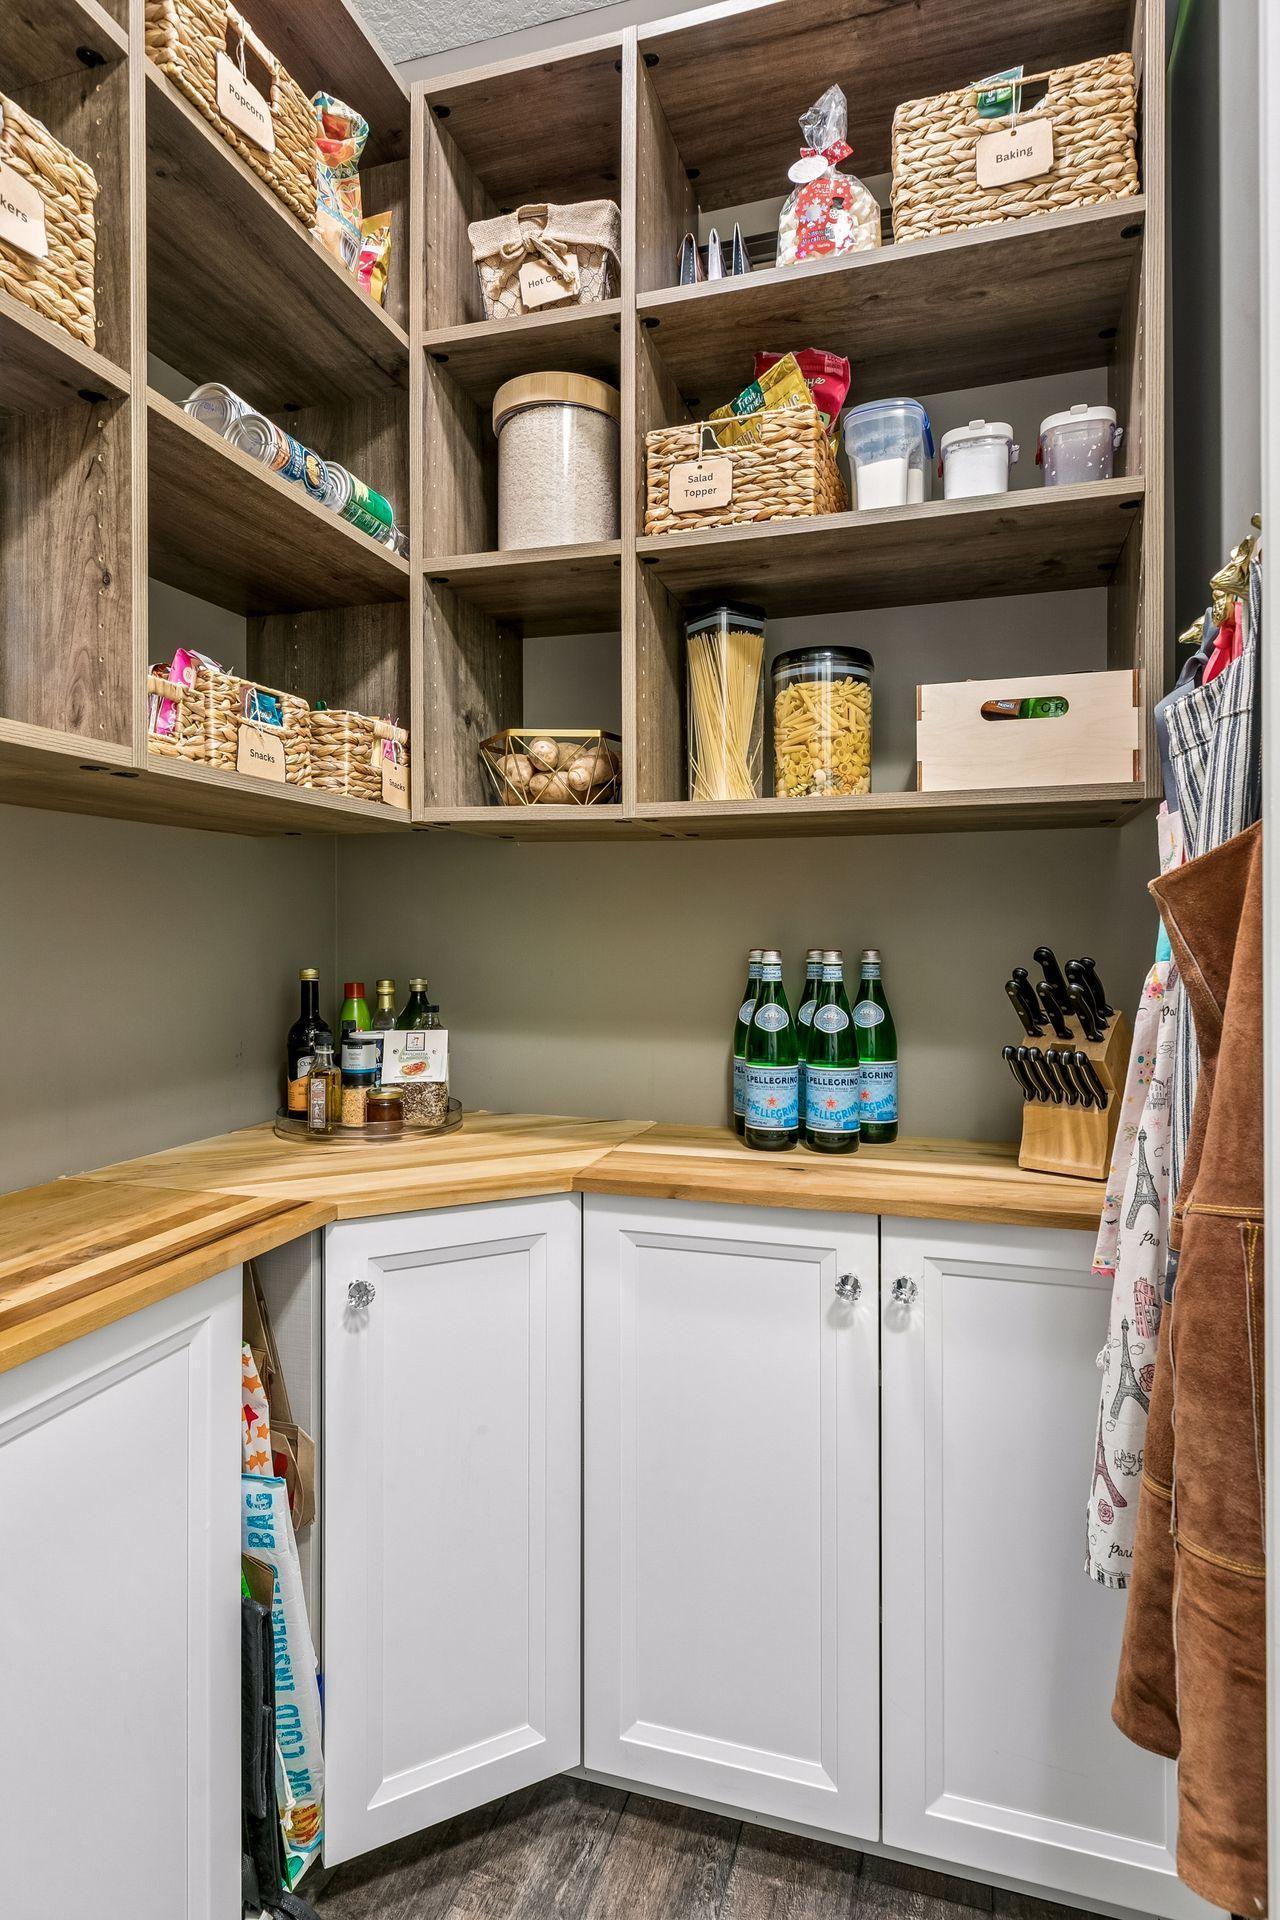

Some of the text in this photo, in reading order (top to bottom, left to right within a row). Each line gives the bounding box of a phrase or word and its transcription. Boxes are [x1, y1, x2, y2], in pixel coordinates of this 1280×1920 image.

[229, 84, 264, 122] Popcorn
[996, 146, 1033, 163] Baking
[528, 274, 564, 288] Hot Coc
[736, 388, 757, 410] Fresh
[688, 473, 713, 483] Salad
[684, 488, 717, 498] Topper
[250, 748, 275, 763] Snacks
[389, 778, 406, 792] Snacks
[246, 1493, 276, 1549] BAG
[1108, 1543, 1133, 1558] Pari
[276, 1704, 305, 1759] COLD
